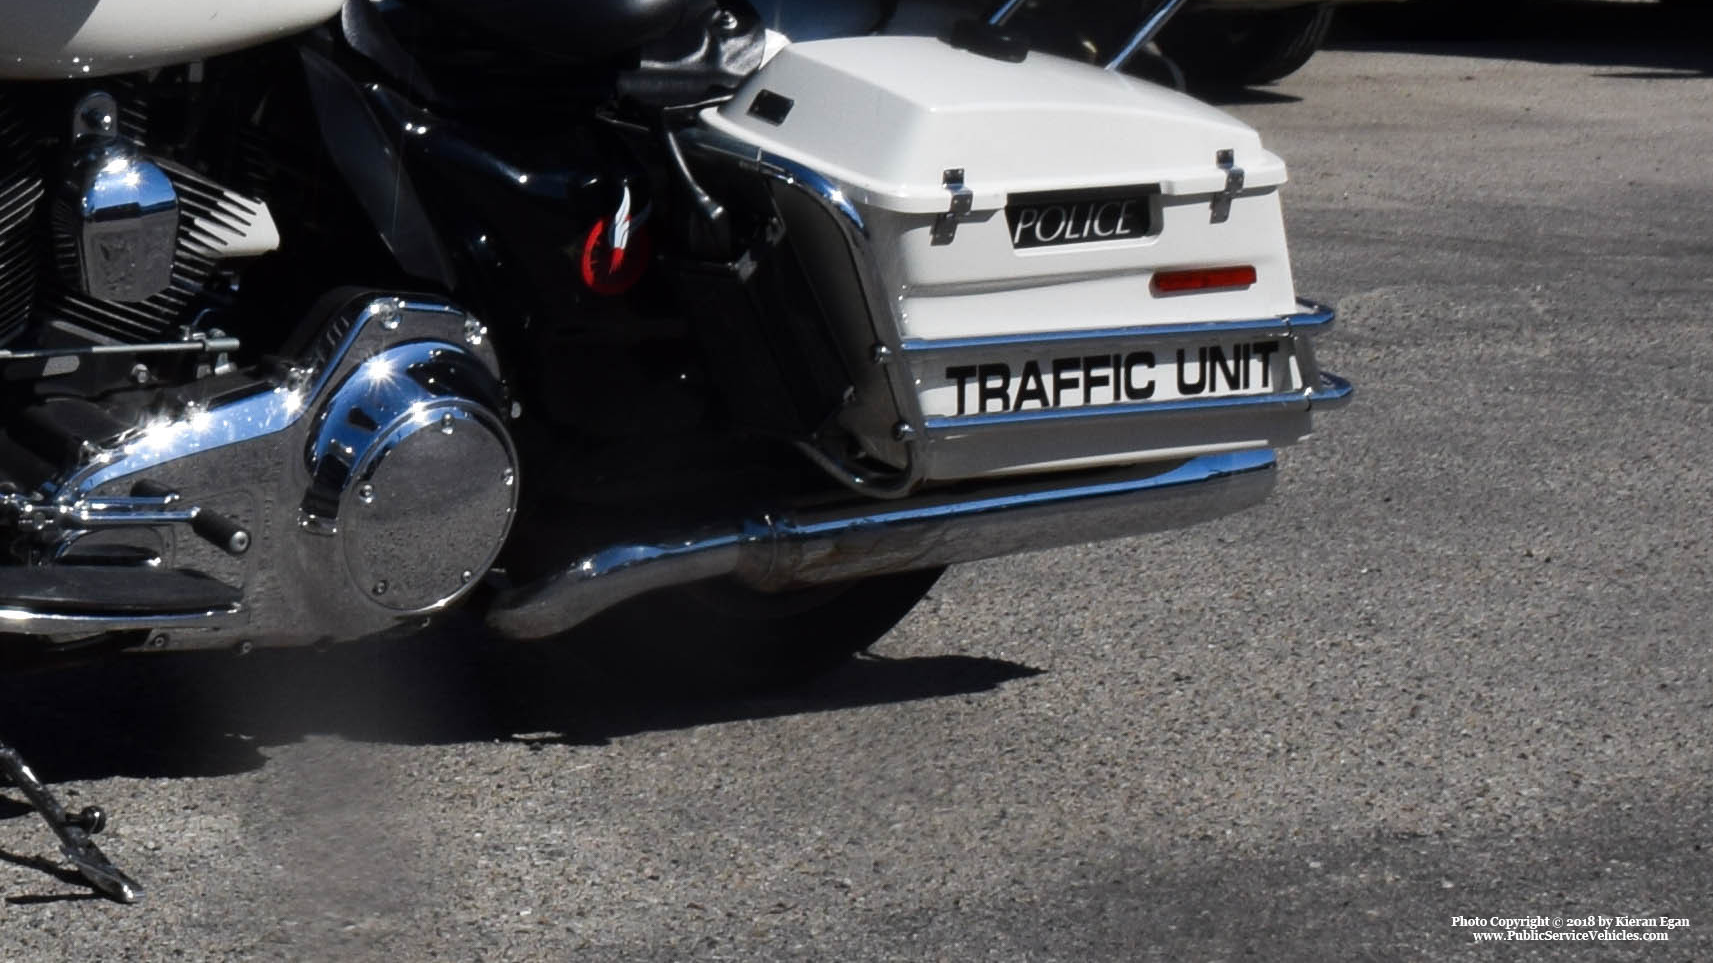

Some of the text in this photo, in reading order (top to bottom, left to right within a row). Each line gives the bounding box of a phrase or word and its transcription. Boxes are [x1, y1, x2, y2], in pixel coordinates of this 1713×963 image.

[1014, 200, 1136, 244] POLICE
[945, 341, 1280, 415] TRAFFIC UNIT
